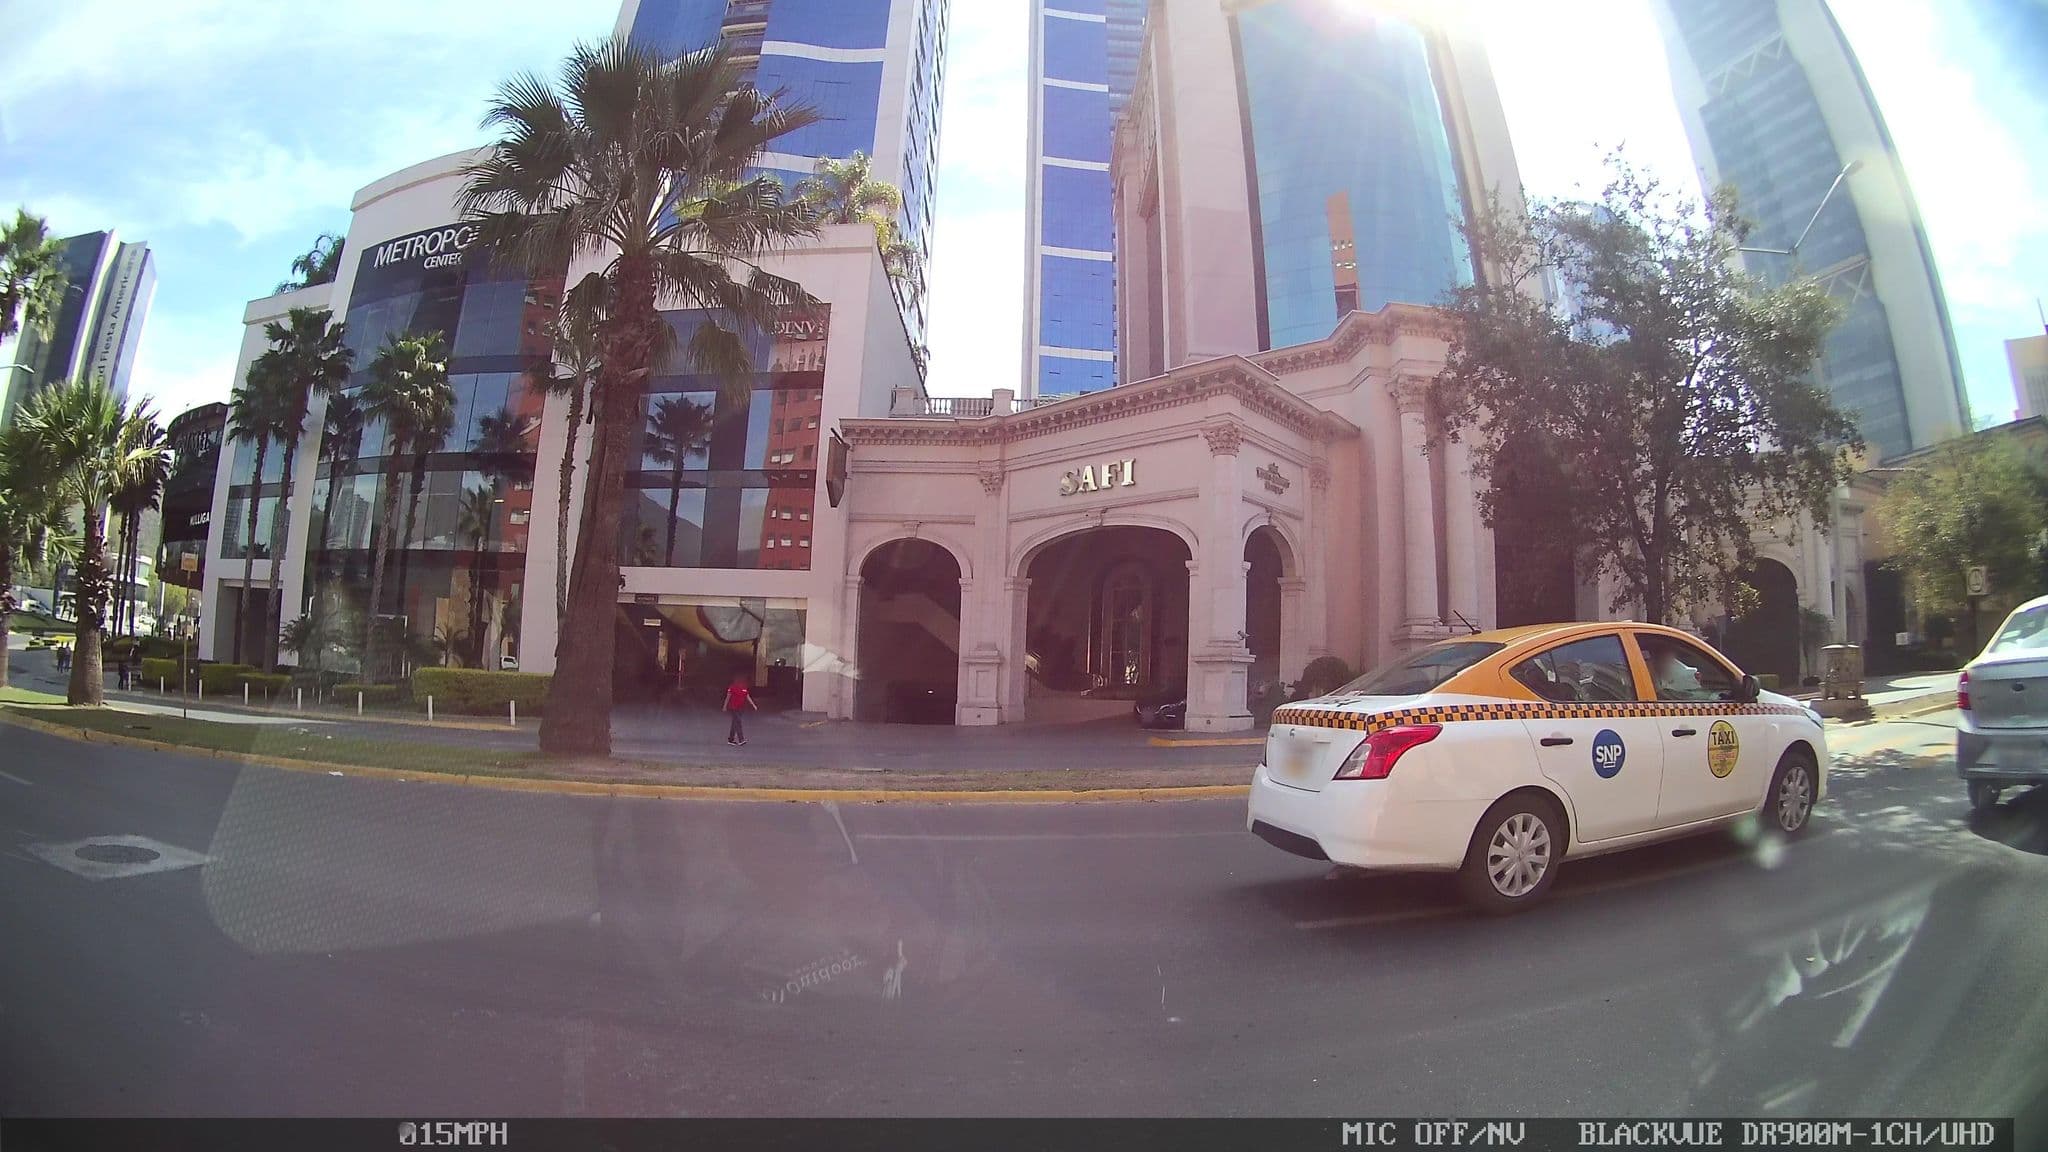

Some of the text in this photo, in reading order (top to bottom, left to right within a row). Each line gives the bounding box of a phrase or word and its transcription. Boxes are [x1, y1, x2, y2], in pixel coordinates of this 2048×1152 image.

[374, 225, 475, 268] METROPO
[100, 322, 117, 362] Fiesta
[1060, 458, 1137, 496] SAFI
[1596, 744, 1622, 763] SNP
[1711, 730, 1735, 746] TAXI
